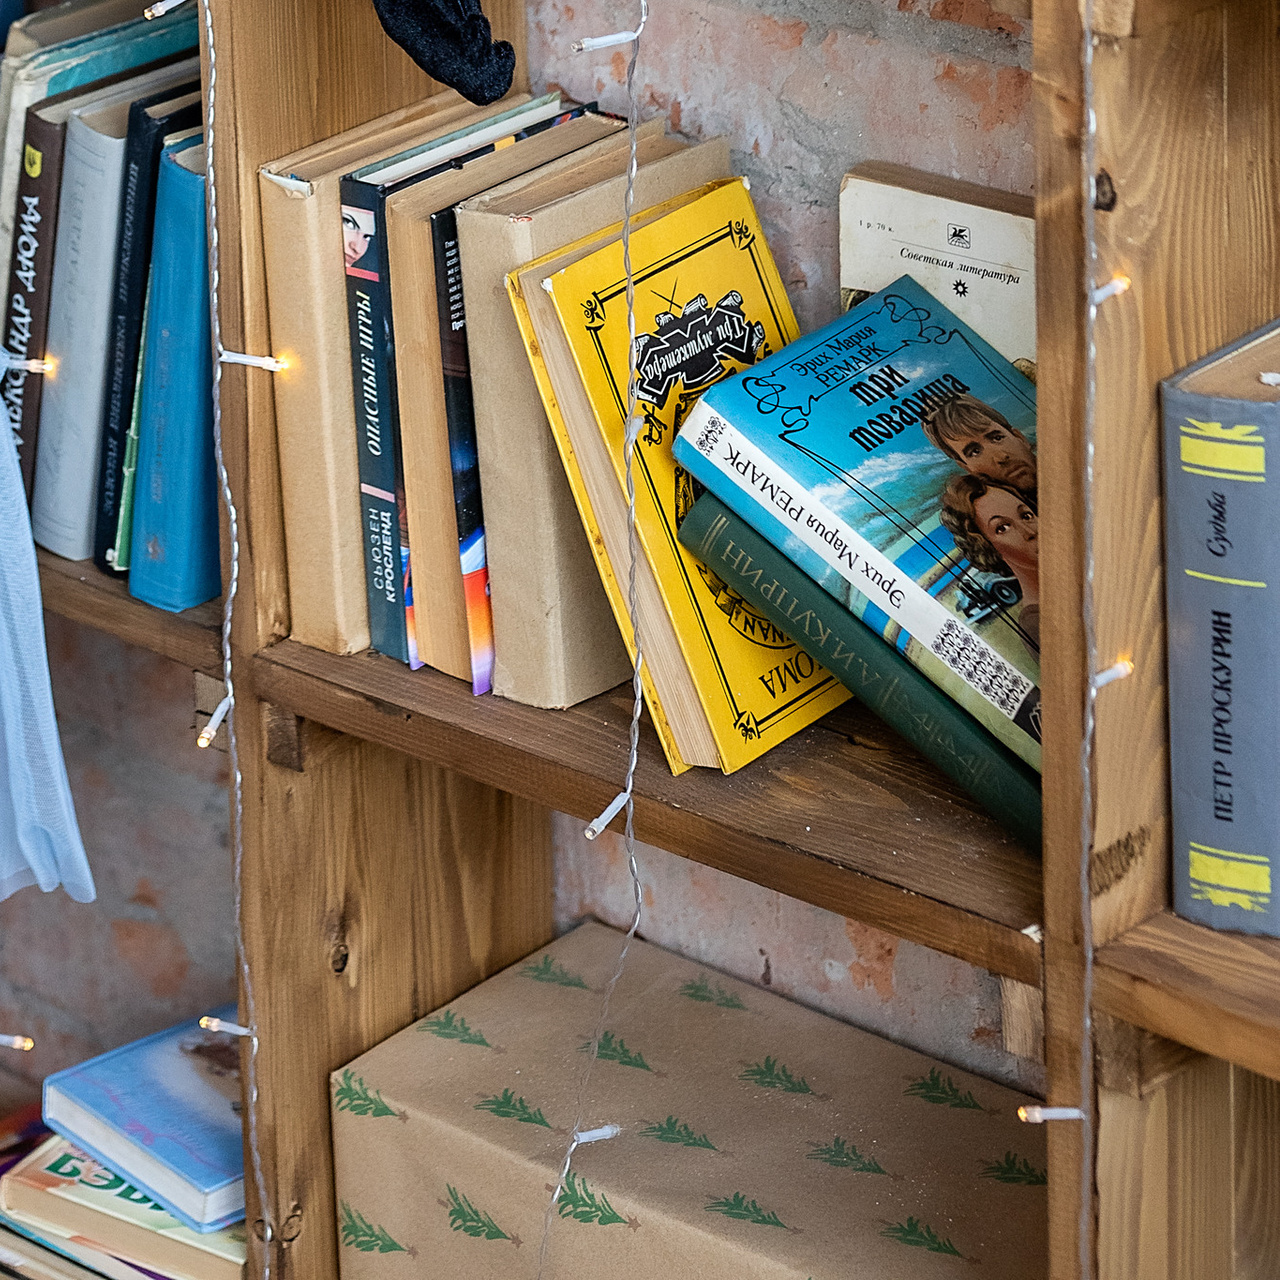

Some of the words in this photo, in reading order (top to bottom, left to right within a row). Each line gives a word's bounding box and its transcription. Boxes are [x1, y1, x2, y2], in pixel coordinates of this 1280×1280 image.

[16, 195, 42, 293] ДЮМА
[899, 247, 954, 269] Советская
[956, 263, 1020, 285] литература
[355, 290, 375, 352] ИГРЫ
[717, 316, 748, 349] Три
[793, 351, 831, 379] Эрих
[828, 323, 876, 360] Мария
[644, 325, 718, 382] мушкетера
[816, 343, 885, 388] РЕМАРК
[848, 359, 910, 408] три
[359, 353, 382, 458] ОПАСНЫЕ
[848, 370, 971, 454] товарища
[723, 441, 813, 525] РЕМАРК
[368, 507, 385, 591] СЬЮЗЕН
[805, 513, 869, 571] Мария
[1205, 491, 1234, 559] Судьба
[377, 510, 397, 604] КРОСЛЕНД
[858, 562, 907, 610] Эрих
[721, 538, 830, 650] КУПРИН
[1211, 609, 1233, 756] ПРОСКУРИН
[1213, 760, 1234, 823] ПЕТР
